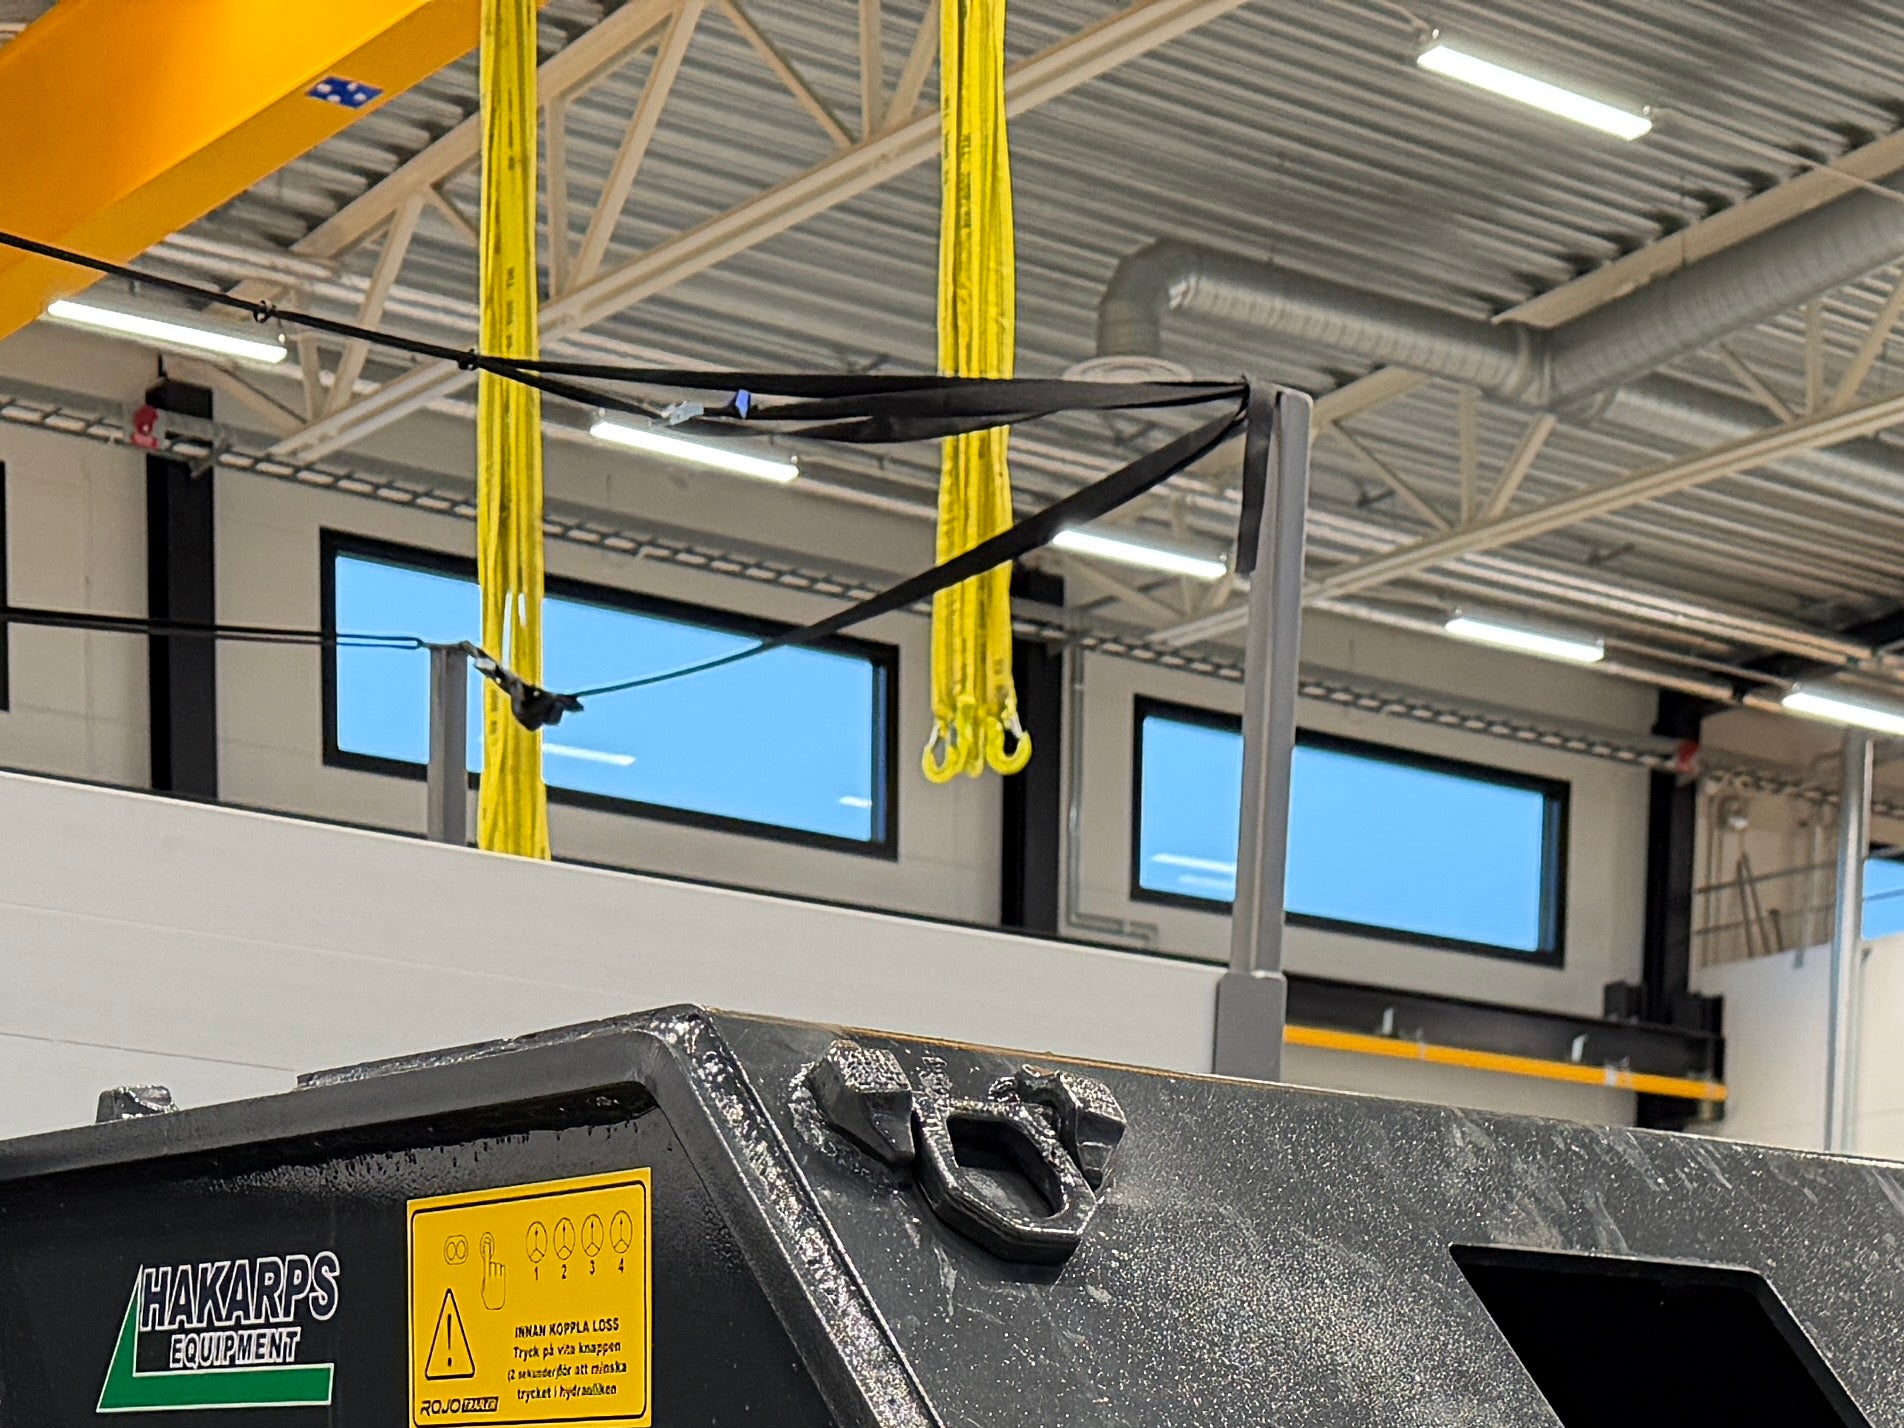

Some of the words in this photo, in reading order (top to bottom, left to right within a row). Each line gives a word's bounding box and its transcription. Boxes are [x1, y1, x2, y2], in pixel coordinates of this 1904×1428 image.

[534, 1266, 540, 1281] 1
[561, 1264, 567, 1280] 2
[589, 1260, 596, 1275] 3
[617, 1257, 625, 1273] 4
[139, 1251, 340, 1332] HAKARPS
[549, 1321, 590, 1336] KOPPLA
[593, 1317, 619, 1332] LOSS
[169, 1327, 302, 1369] EQUIPMENT
[514, 1345, 539, 1362] Tryck
[578, 1341, 621, 1356] knappen
[420, 1398, 461, 1416] ROJO
